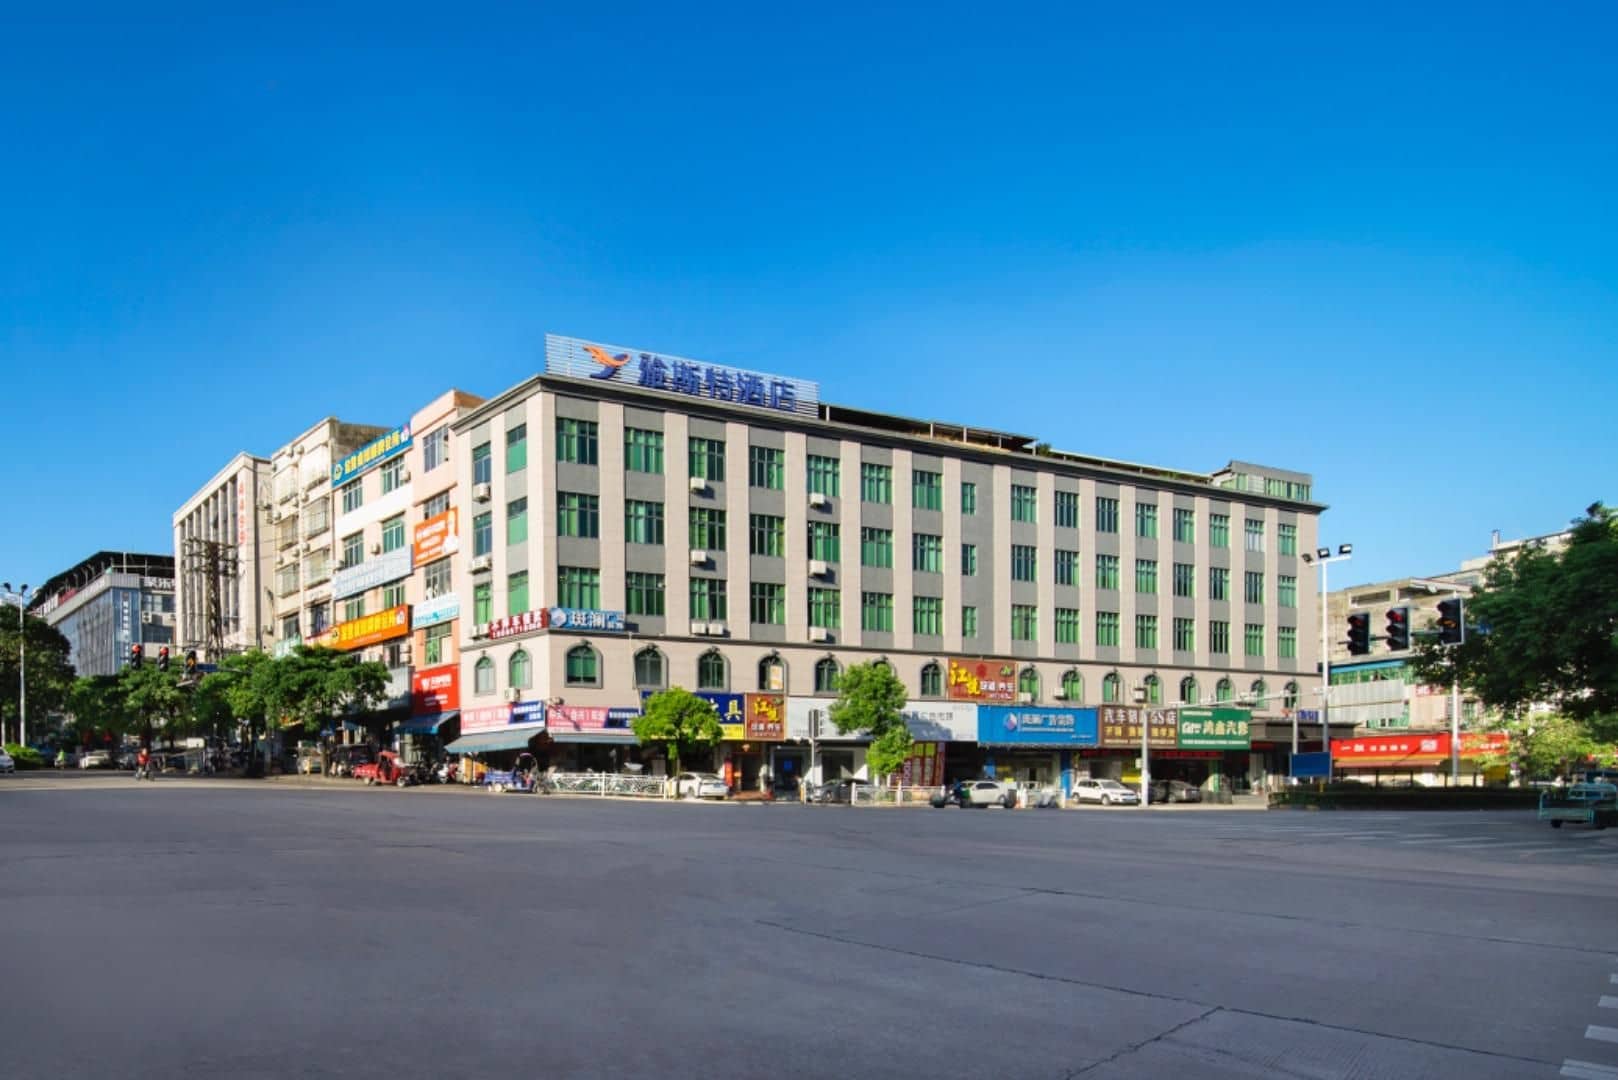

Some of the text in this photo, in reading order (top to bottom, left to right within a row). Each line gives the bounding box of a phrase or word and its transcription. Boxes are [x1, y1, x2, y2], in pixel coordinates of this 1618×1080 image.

[638, 352, 797, 412] 雅斯特酒店
